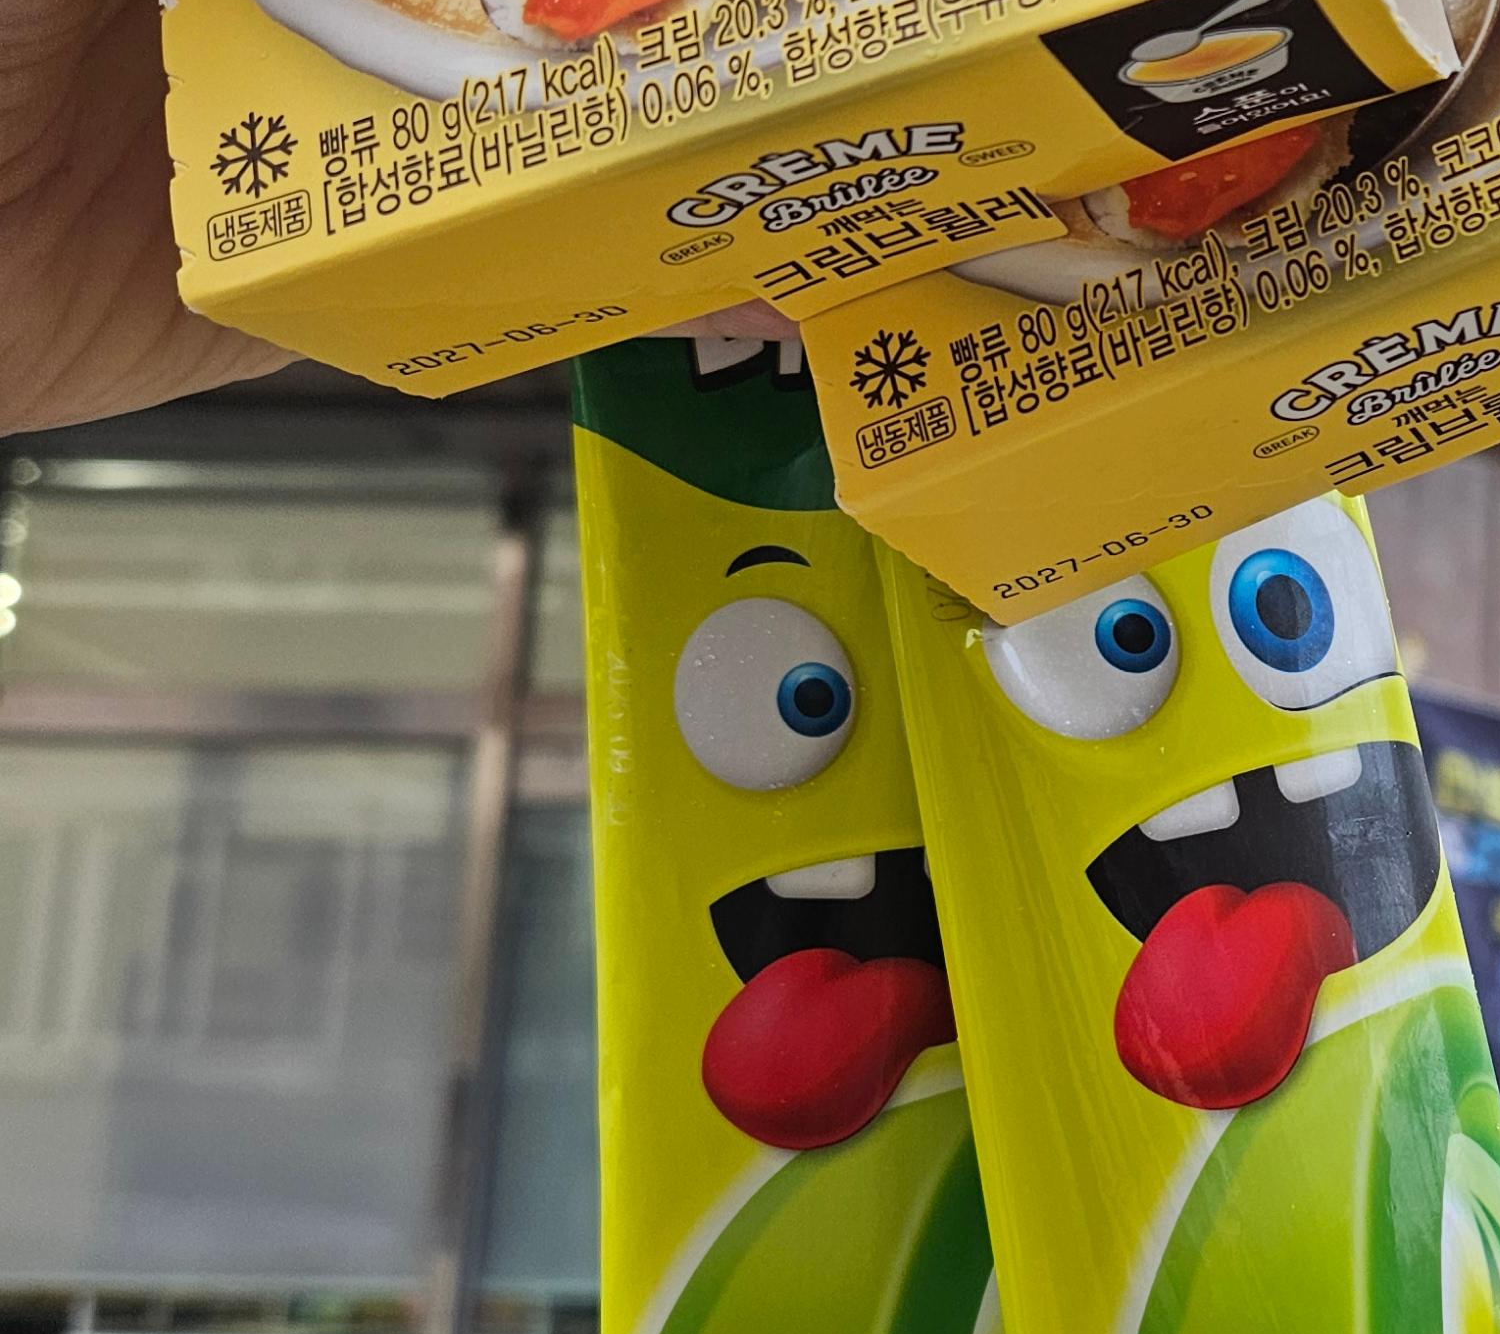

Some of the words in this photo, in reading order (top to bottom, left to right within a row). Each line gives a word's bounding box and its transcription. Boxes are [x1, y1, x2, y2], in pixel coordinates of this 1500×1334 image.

[319, 117, 381, 179] 빵류
[392, 103, 431, 146] 80
[441, 70, 529, 143] g(217
[541, 33, 627, 98] kcal),
[637, 10, 702, 71] 크림
[1193, 82, 1309, 125] 스푼이
[323, 85, 630, 237] [합성향료(바닐린향)
[641, 64, 717, 127] 0.06
[729, 50, 771, 100] %,
[667, 121, 965, 228] CRÈME
[963, 141, 1030, 166] SWEET
[212, 195, 308, 257] 냉동제품
[762, 166, 939, 233] Brûlée
[817, 198, 926, 237] 깨먹는
[668, 233, 729, 264] BREAK
[753, 186, 1053, 302] 크림브륄레
[949, 323, 1012, 387] 빵류
[1018, 306, 1057, 354] 80
[1066, 269, 1146, 342] g(217
[1159, 231, 1239, 297] kcal),
[1244, 200, 1308, 262] 크림
[1314, 172, 1383, 236] 20.3
[1387, 156, 1431, 200] %,
[386, 305, 630, 378] 2027-06-30
[959, 279, 1250, 436] [합성향료(바닐린향)
[1256, 250, 1331, 310] 0.06
[1335, 235, 1382, 281] %,
[861, 406, 952, 463] 냉동제품
[1391, 384, 1488, 428] 깨먹는
[1259, 426, 1316, 457] BREAK
[992, 503, 1215, 600] 2027-06-30
